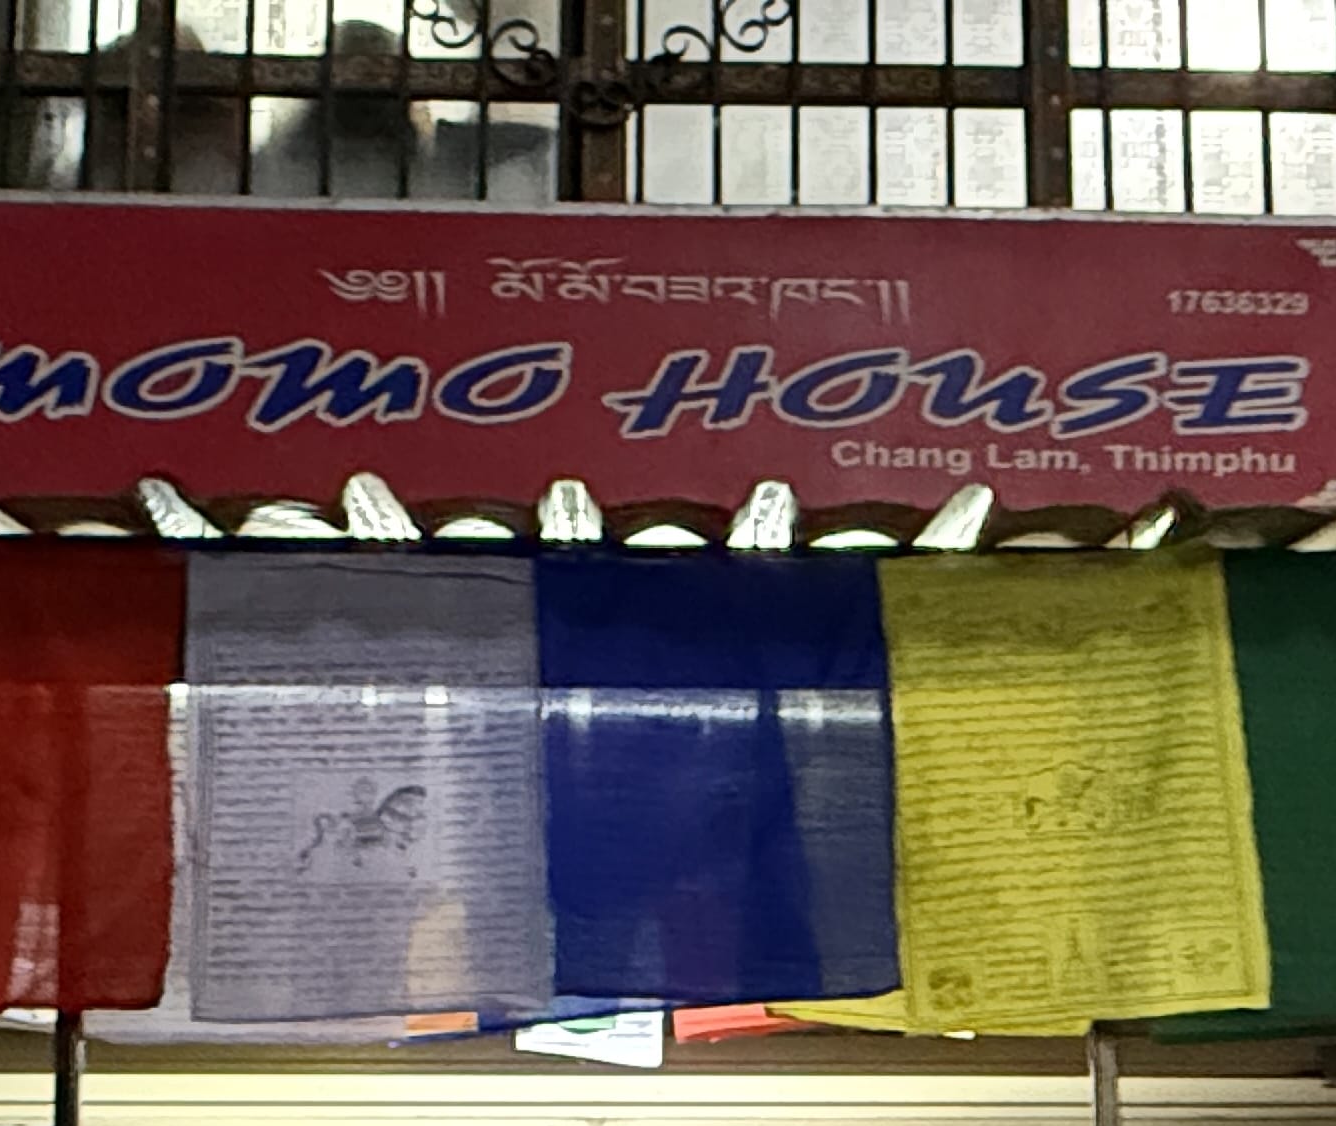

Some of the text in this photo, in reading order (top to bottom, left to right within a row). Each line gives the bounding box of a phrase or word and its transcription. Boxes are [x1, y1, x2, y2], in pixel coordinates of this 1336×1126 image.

[1167, 290, 1309, 315] 17636329
[831, 440, 1296, 477] Chang Lam, Thimphu
